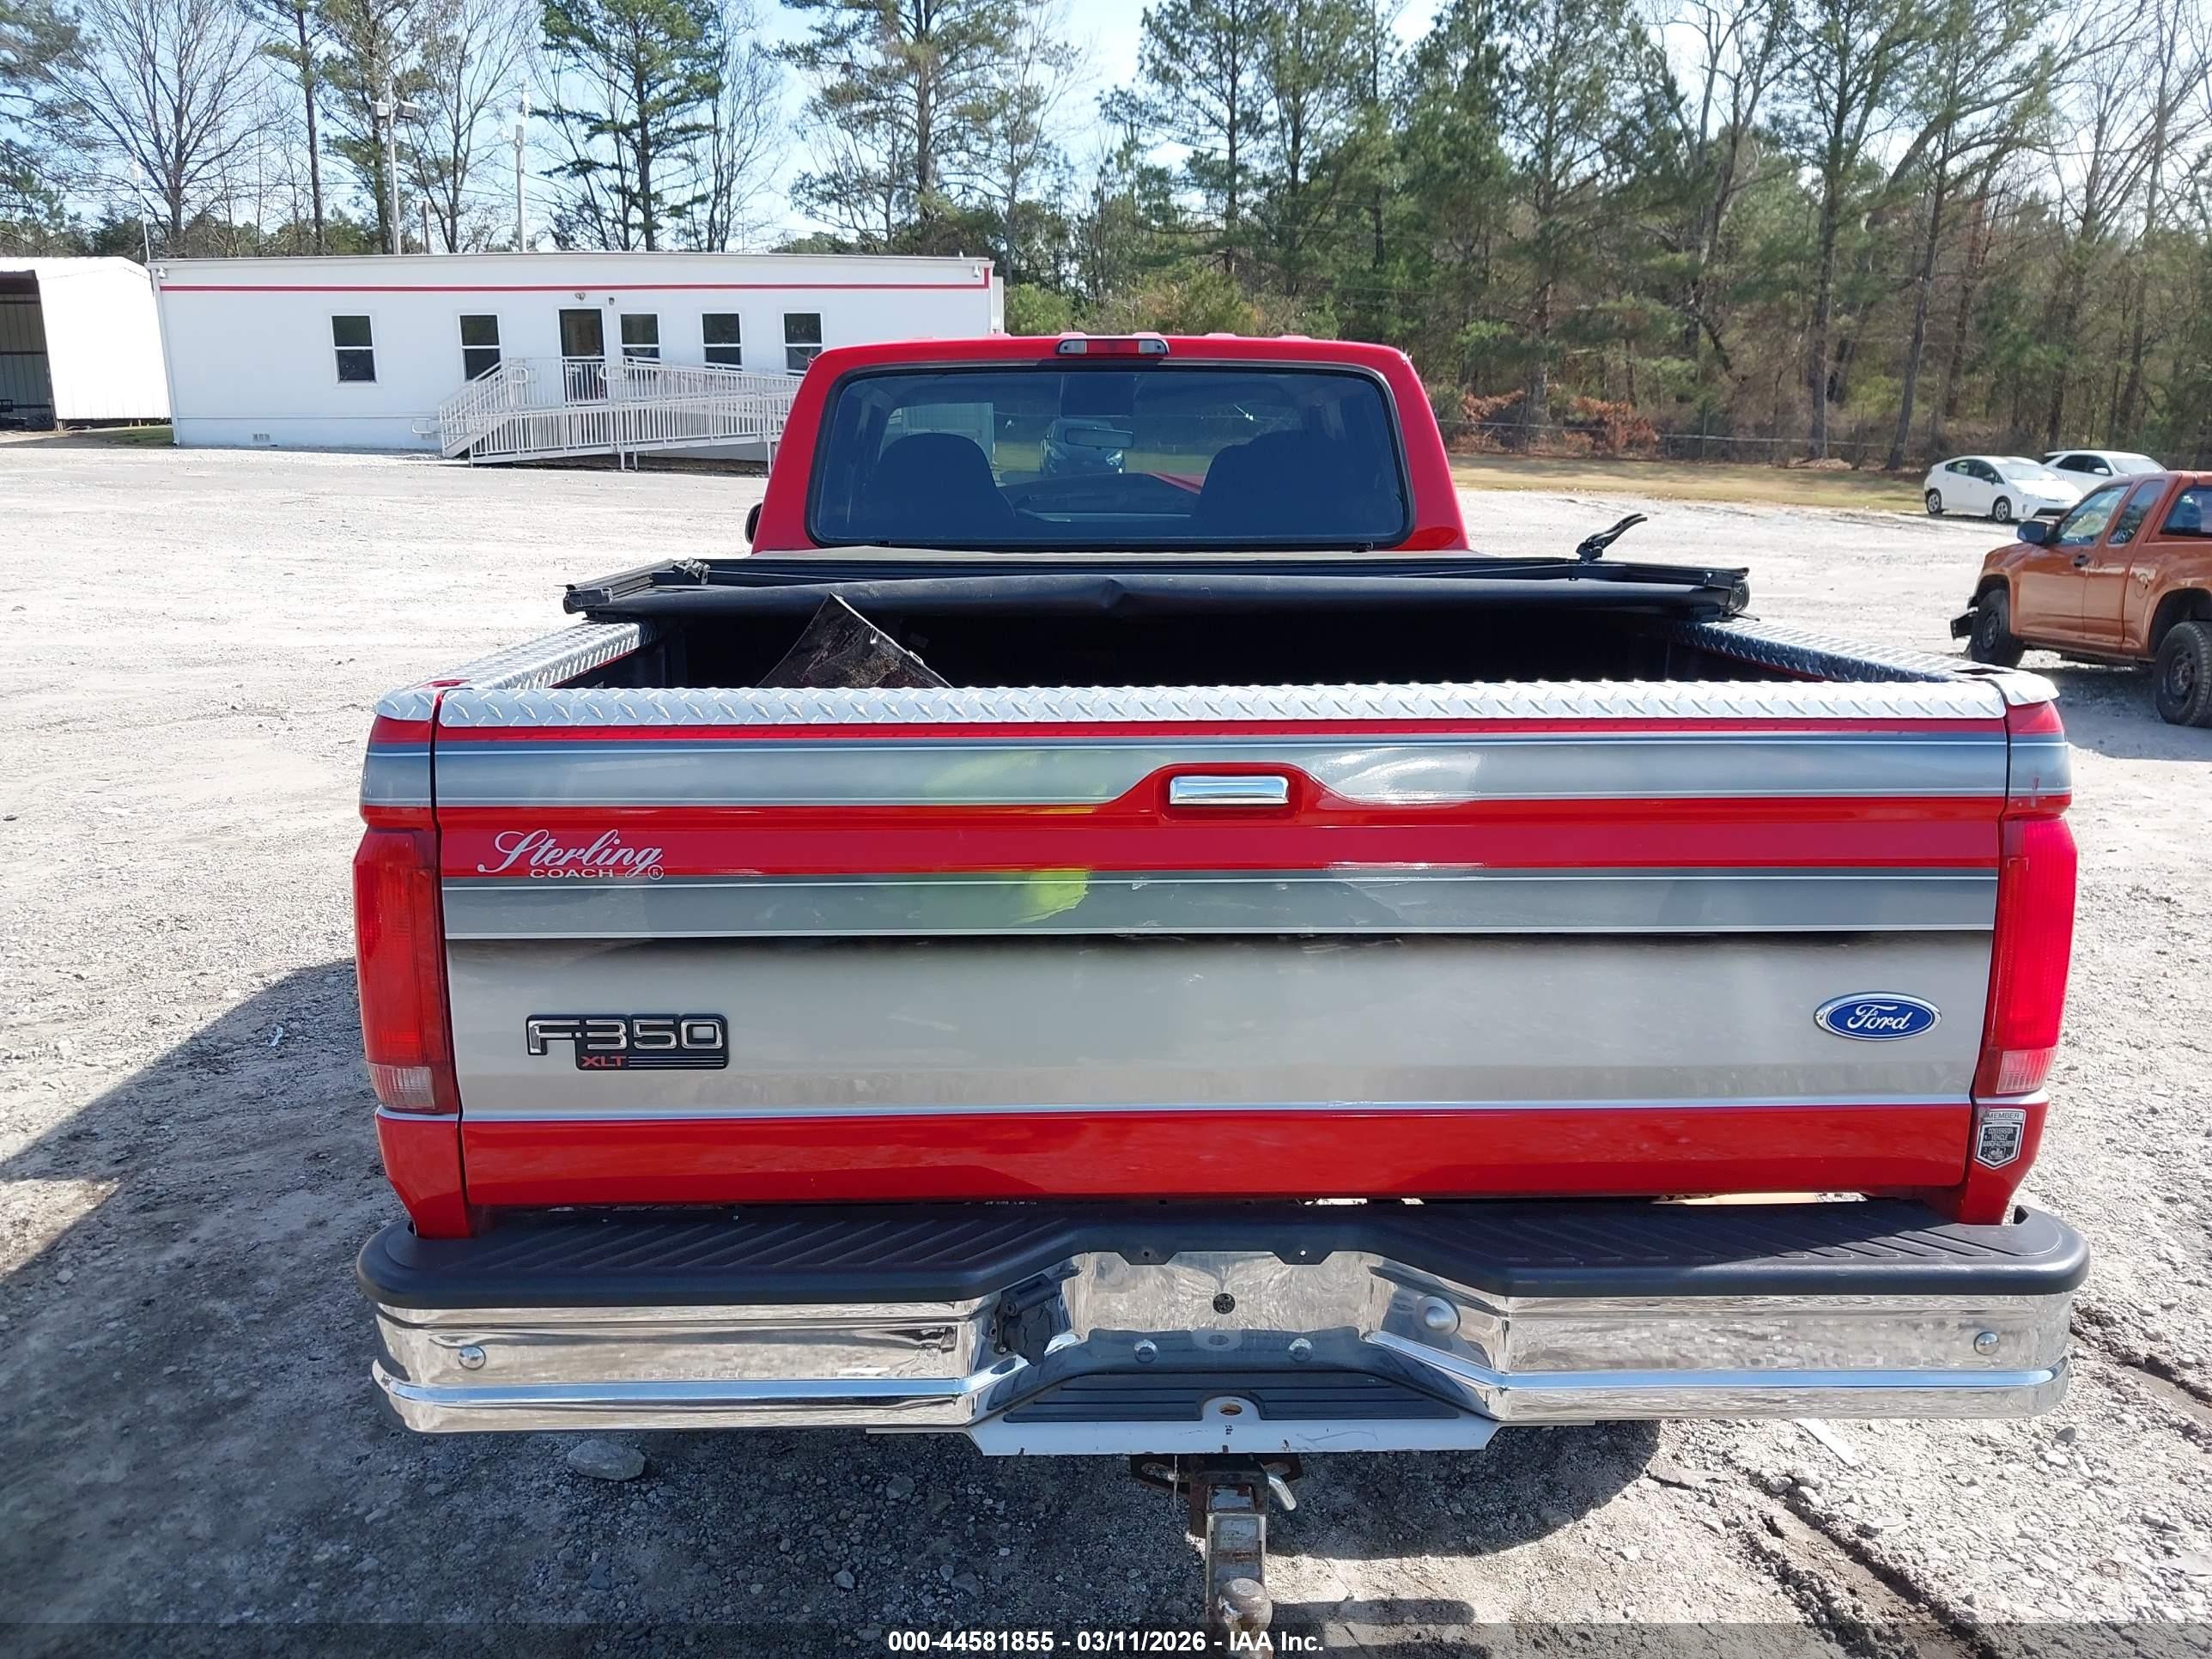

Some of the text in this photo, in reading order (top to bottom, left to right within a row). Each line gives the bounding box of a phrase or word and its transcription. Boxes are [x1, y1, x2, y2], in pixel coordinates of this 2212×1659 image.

[477, 829, 664, 879] Sterling
[529, 868, 614, 878] COACH
[1847, 1004, 1913, 1030] Ford
[580, 1055, 627, 1067] XLT
